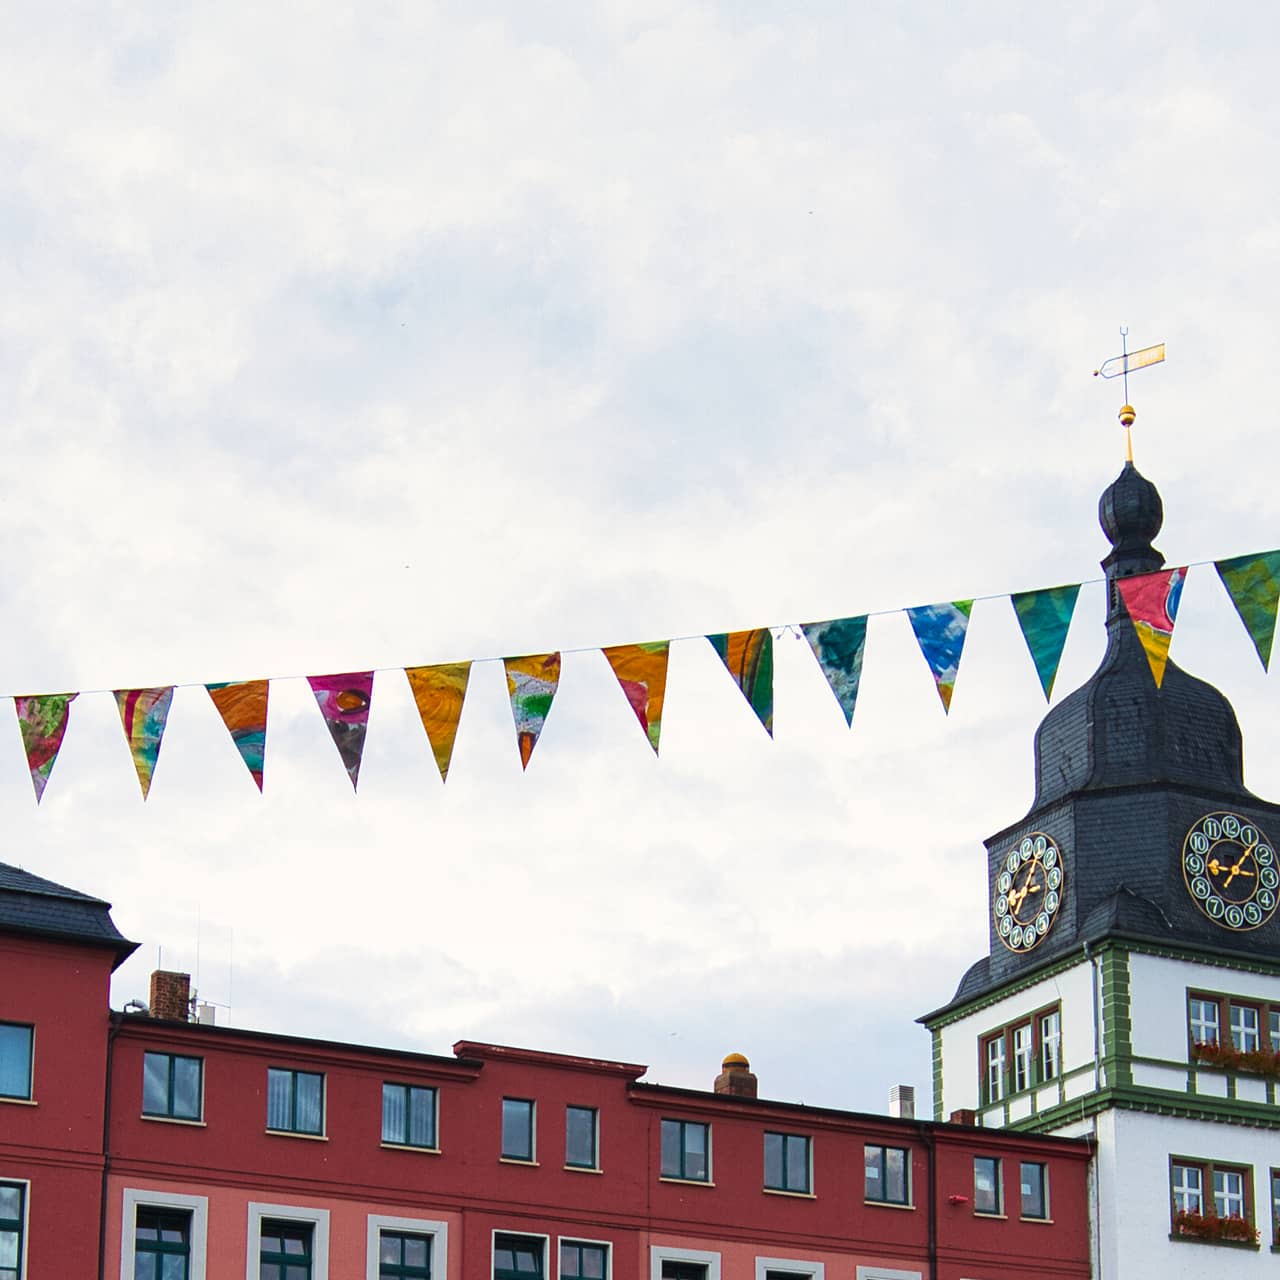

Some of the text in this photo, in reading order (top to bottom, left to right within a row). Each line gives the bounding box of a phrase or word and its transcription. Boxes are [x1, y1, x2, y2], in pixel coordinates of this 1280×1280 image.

[1208, 822, 1217, 837] 11
[1225, 819, 1236, 834] 12
[1194, 836, 1206, 851] 10
[1246, 829, 1252, 843] 1
[1259, 847, 1269, 863] 2
[1190, 856, 1200, 872] 9
[1264, 870, 1274, 885] 3
[1196, 881, 1206, 896] 8
[1211, 899, 1219, 914] 7
[1260, 892, 1271, 907] 4
[1229, 910, 1239, 924] 6
[1248, 906, 1258, 921] 5
